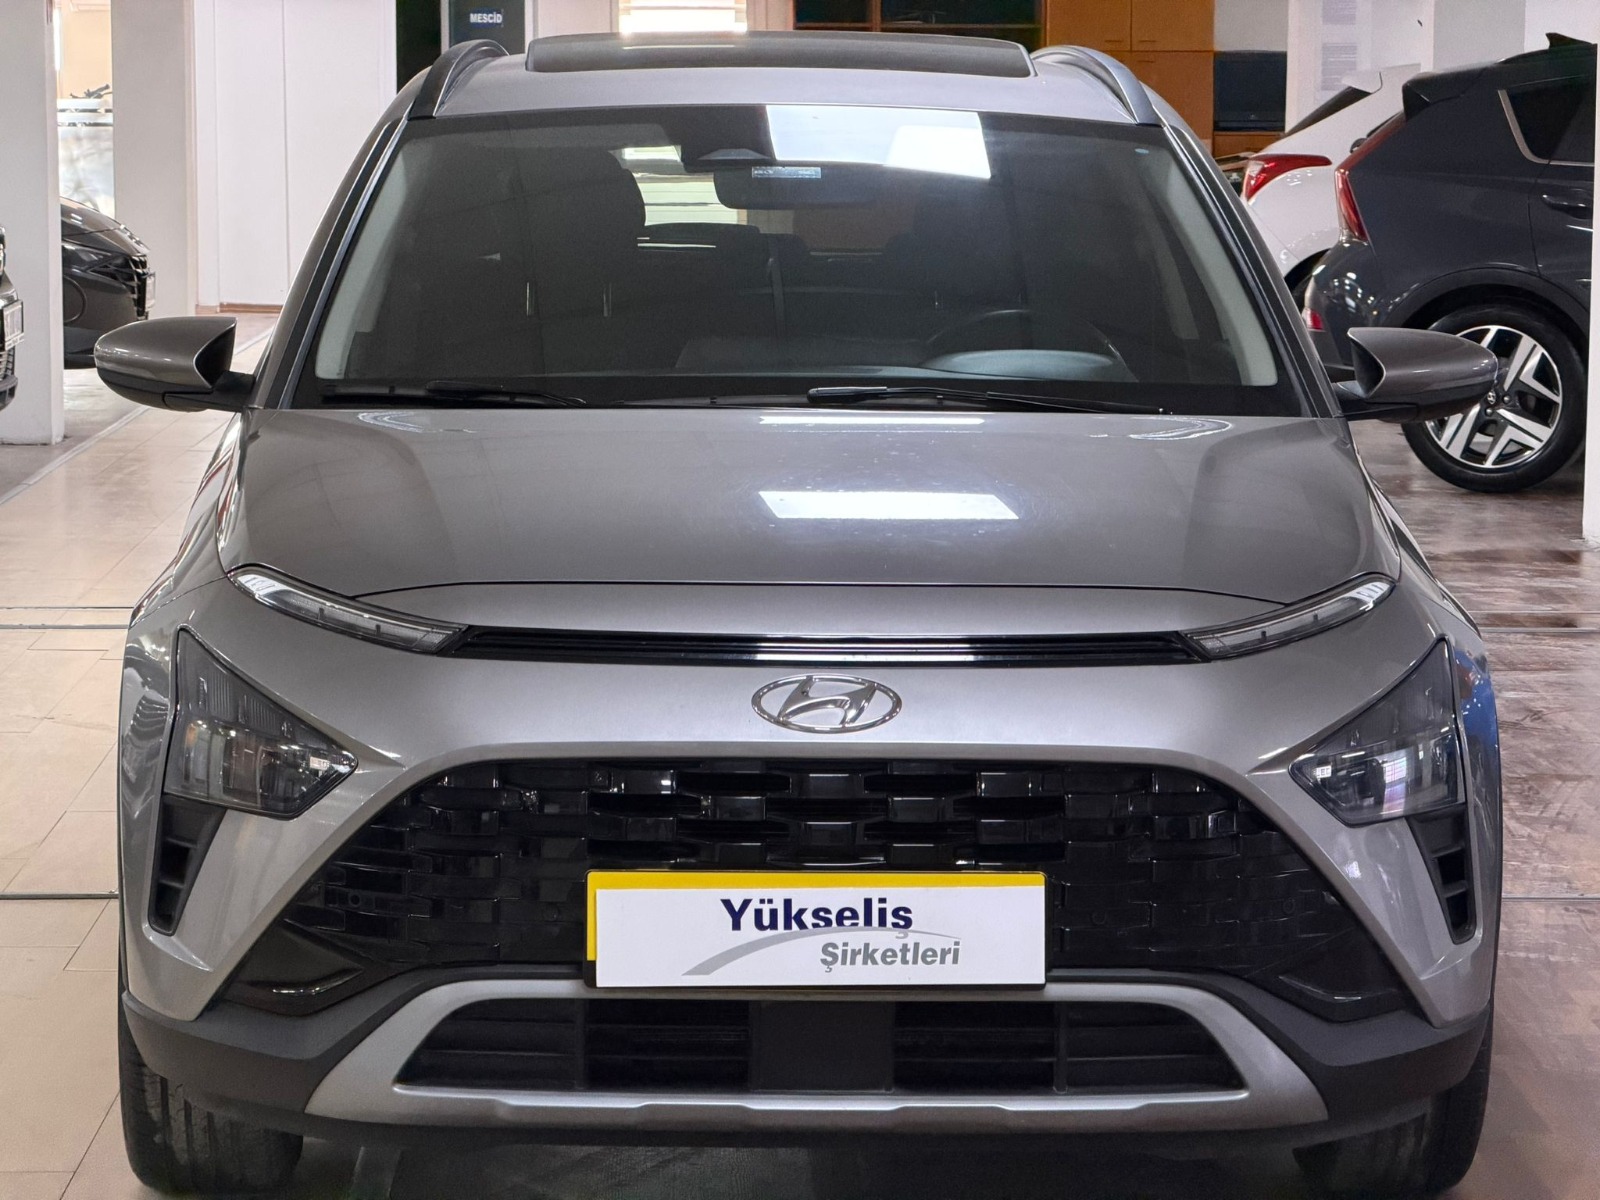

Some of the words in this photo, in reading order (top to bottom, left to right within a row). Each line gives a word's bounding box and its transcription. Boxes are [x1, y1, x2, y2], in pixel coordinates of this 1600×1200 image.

[469, 12, 503, 23] MESCİD
[720, 897, 913, 938] Yükseliş
[820, 940, 961, 973] Şirketleri
